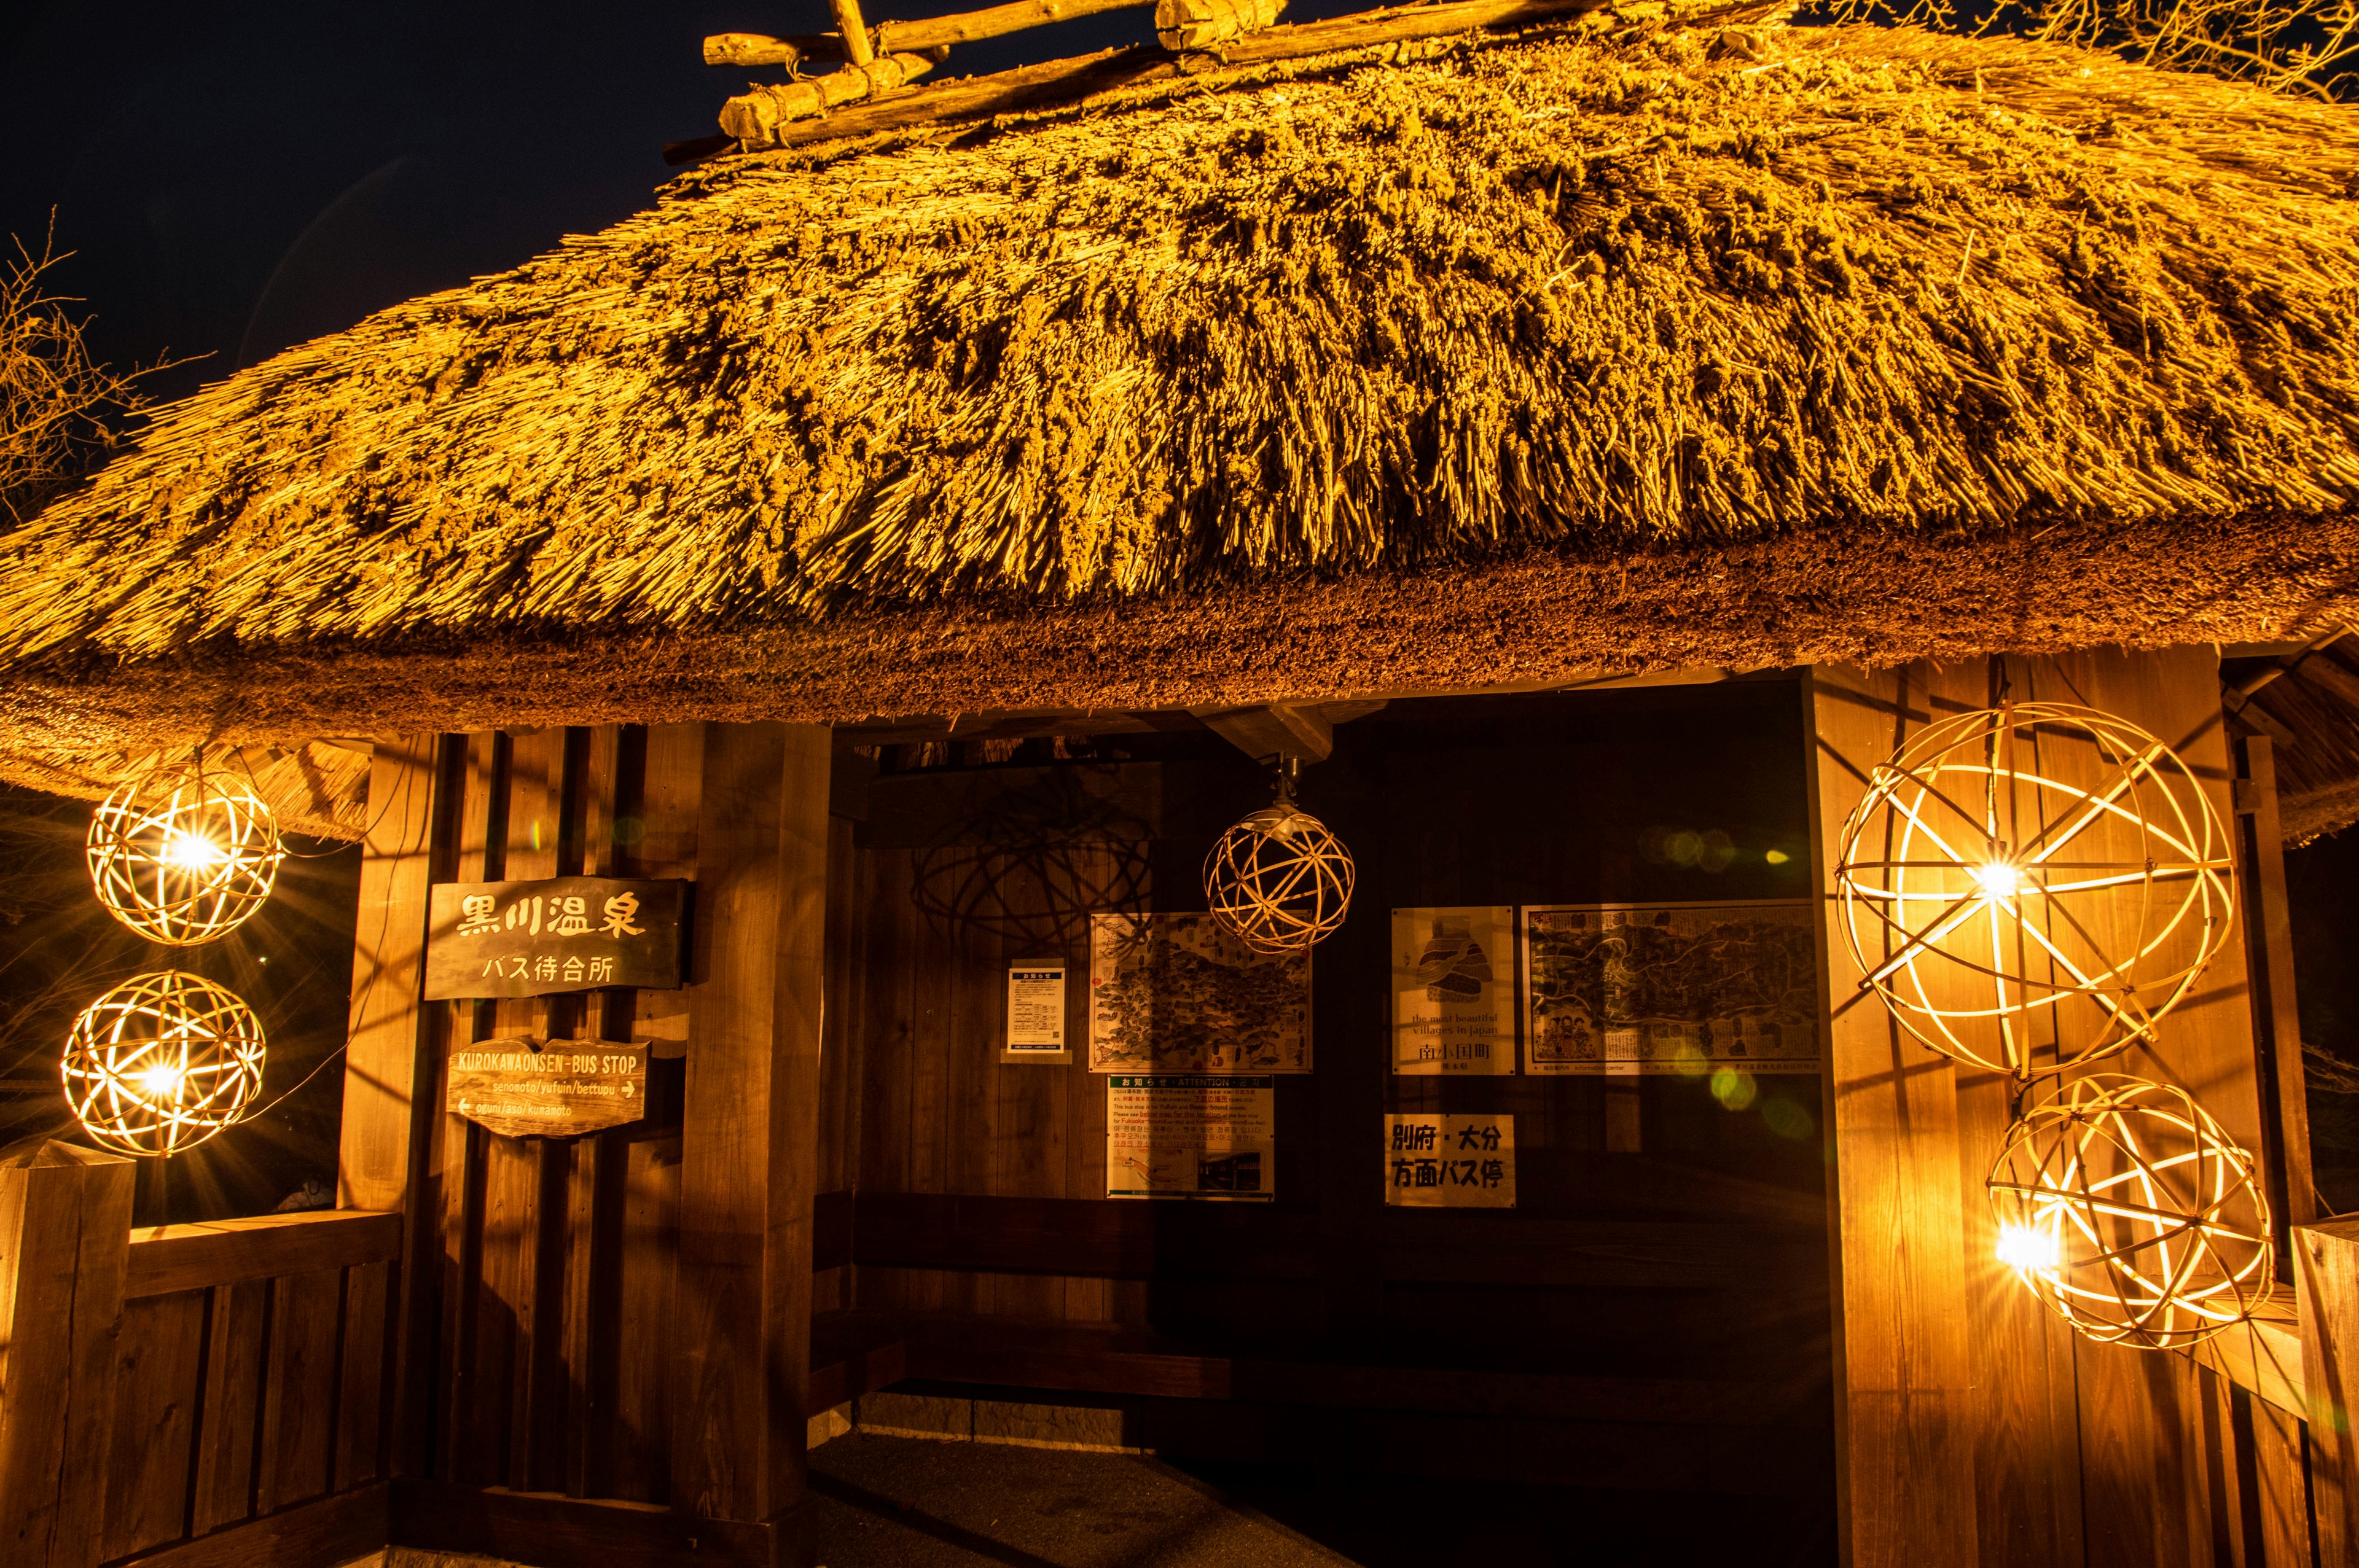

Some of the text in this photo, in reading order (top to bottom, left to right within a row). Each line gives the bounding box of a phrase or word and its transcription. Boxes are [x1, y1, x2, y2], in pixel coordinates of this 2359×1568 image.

[456, 891, 646, 938] 黒川温泉
[482, 955, 613, 983] バス待合所
[1412, 1014, 1426, 1023] the
[1456, 1013, 1498, 1023] beautiful
[1413, 1025, 1498, 1037] villages in japan
[1420, 1043, 1490, 1059] 南小国町
[603, 1055, 636, 1075] STOP
[1122, 1078, 1167, 1086] お知らせ
[476, 1101, 571, 1117] oguni/aso/kumamoto
[1391, 1125, 1501, 1150] 別府・大分
[1391, 1158, 1503, 1188] 方面バス停
